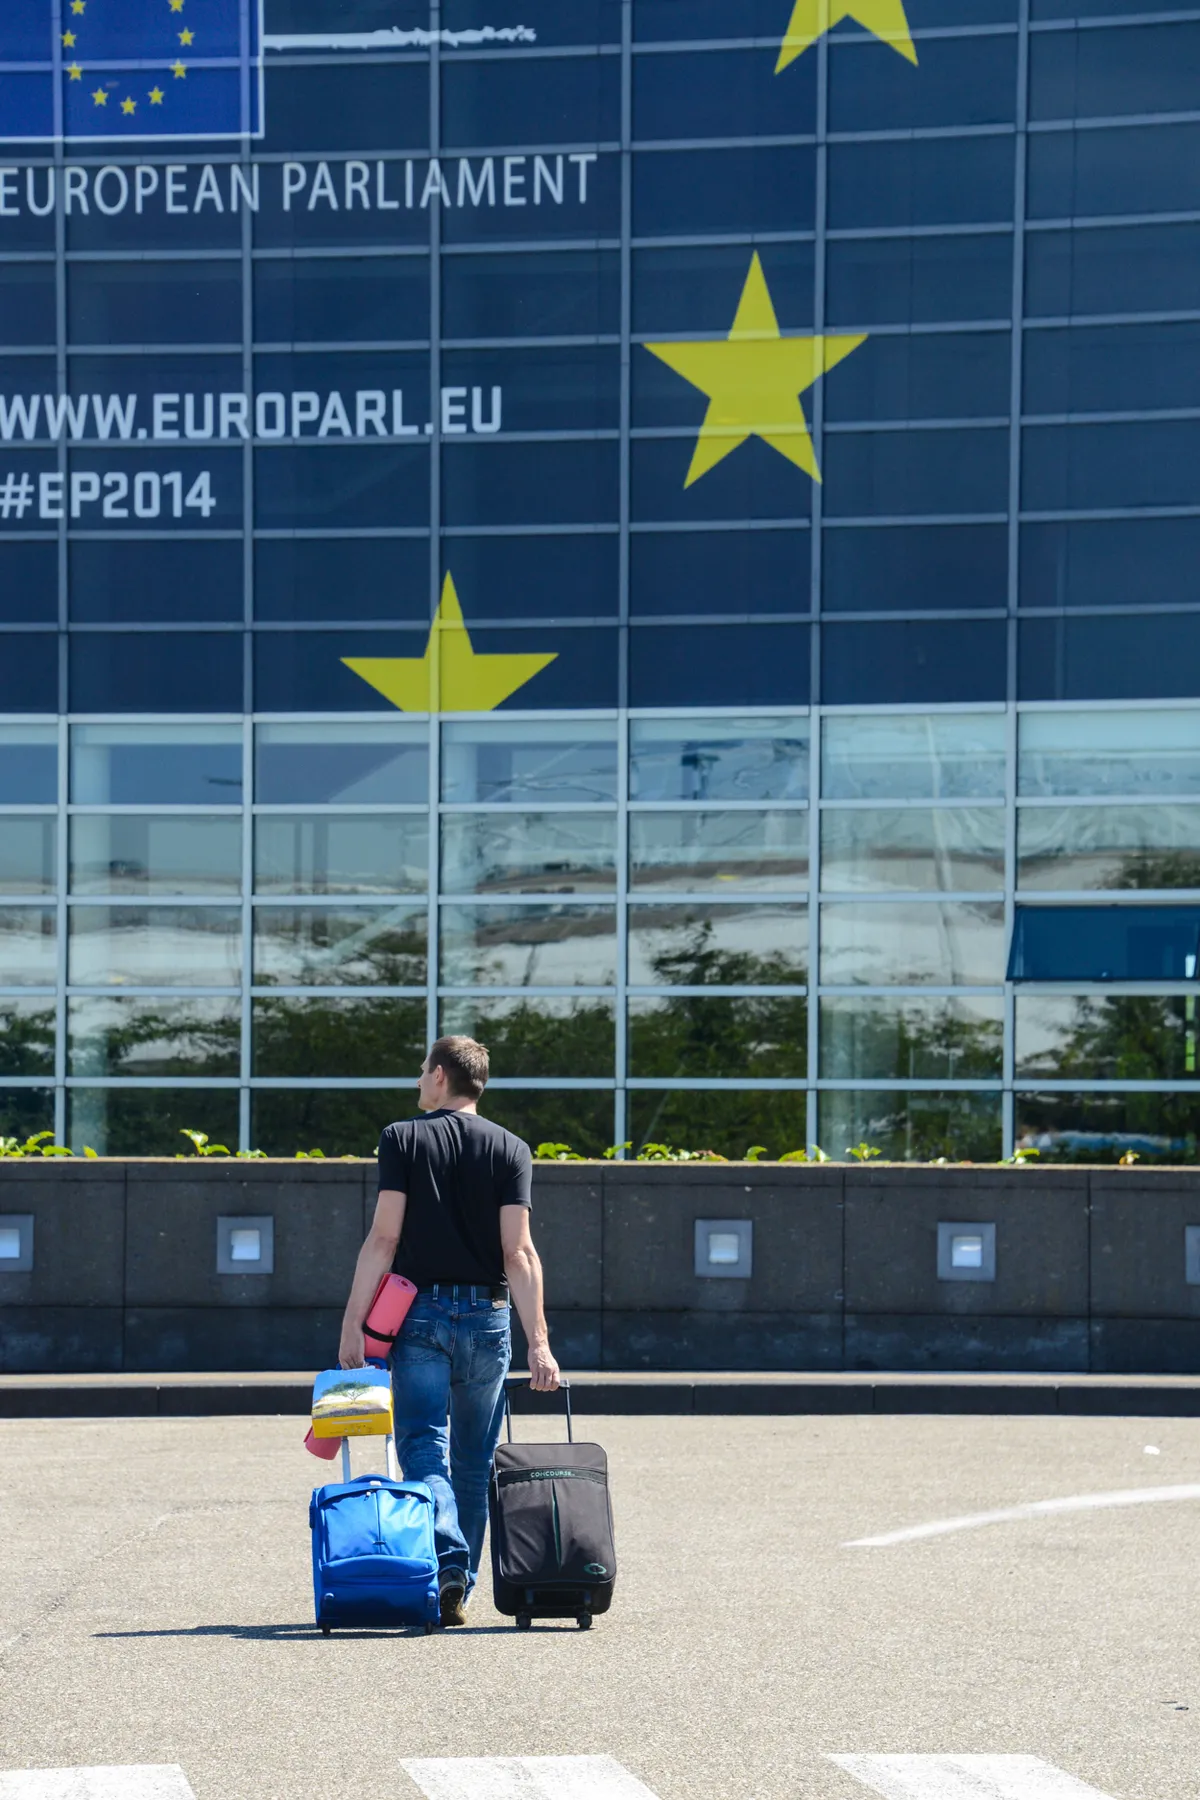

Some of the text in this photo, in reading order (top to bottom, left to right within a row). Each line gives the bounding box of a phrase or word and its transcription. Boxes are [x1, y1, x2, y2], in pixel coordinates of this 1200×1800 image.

[0, 153, 598, 216] EUROPEAN PARLIAMENT
[0, 386, 502, 441] WWW.EUROPARL.EU
[0, 471, 216, 519] #EP2014
